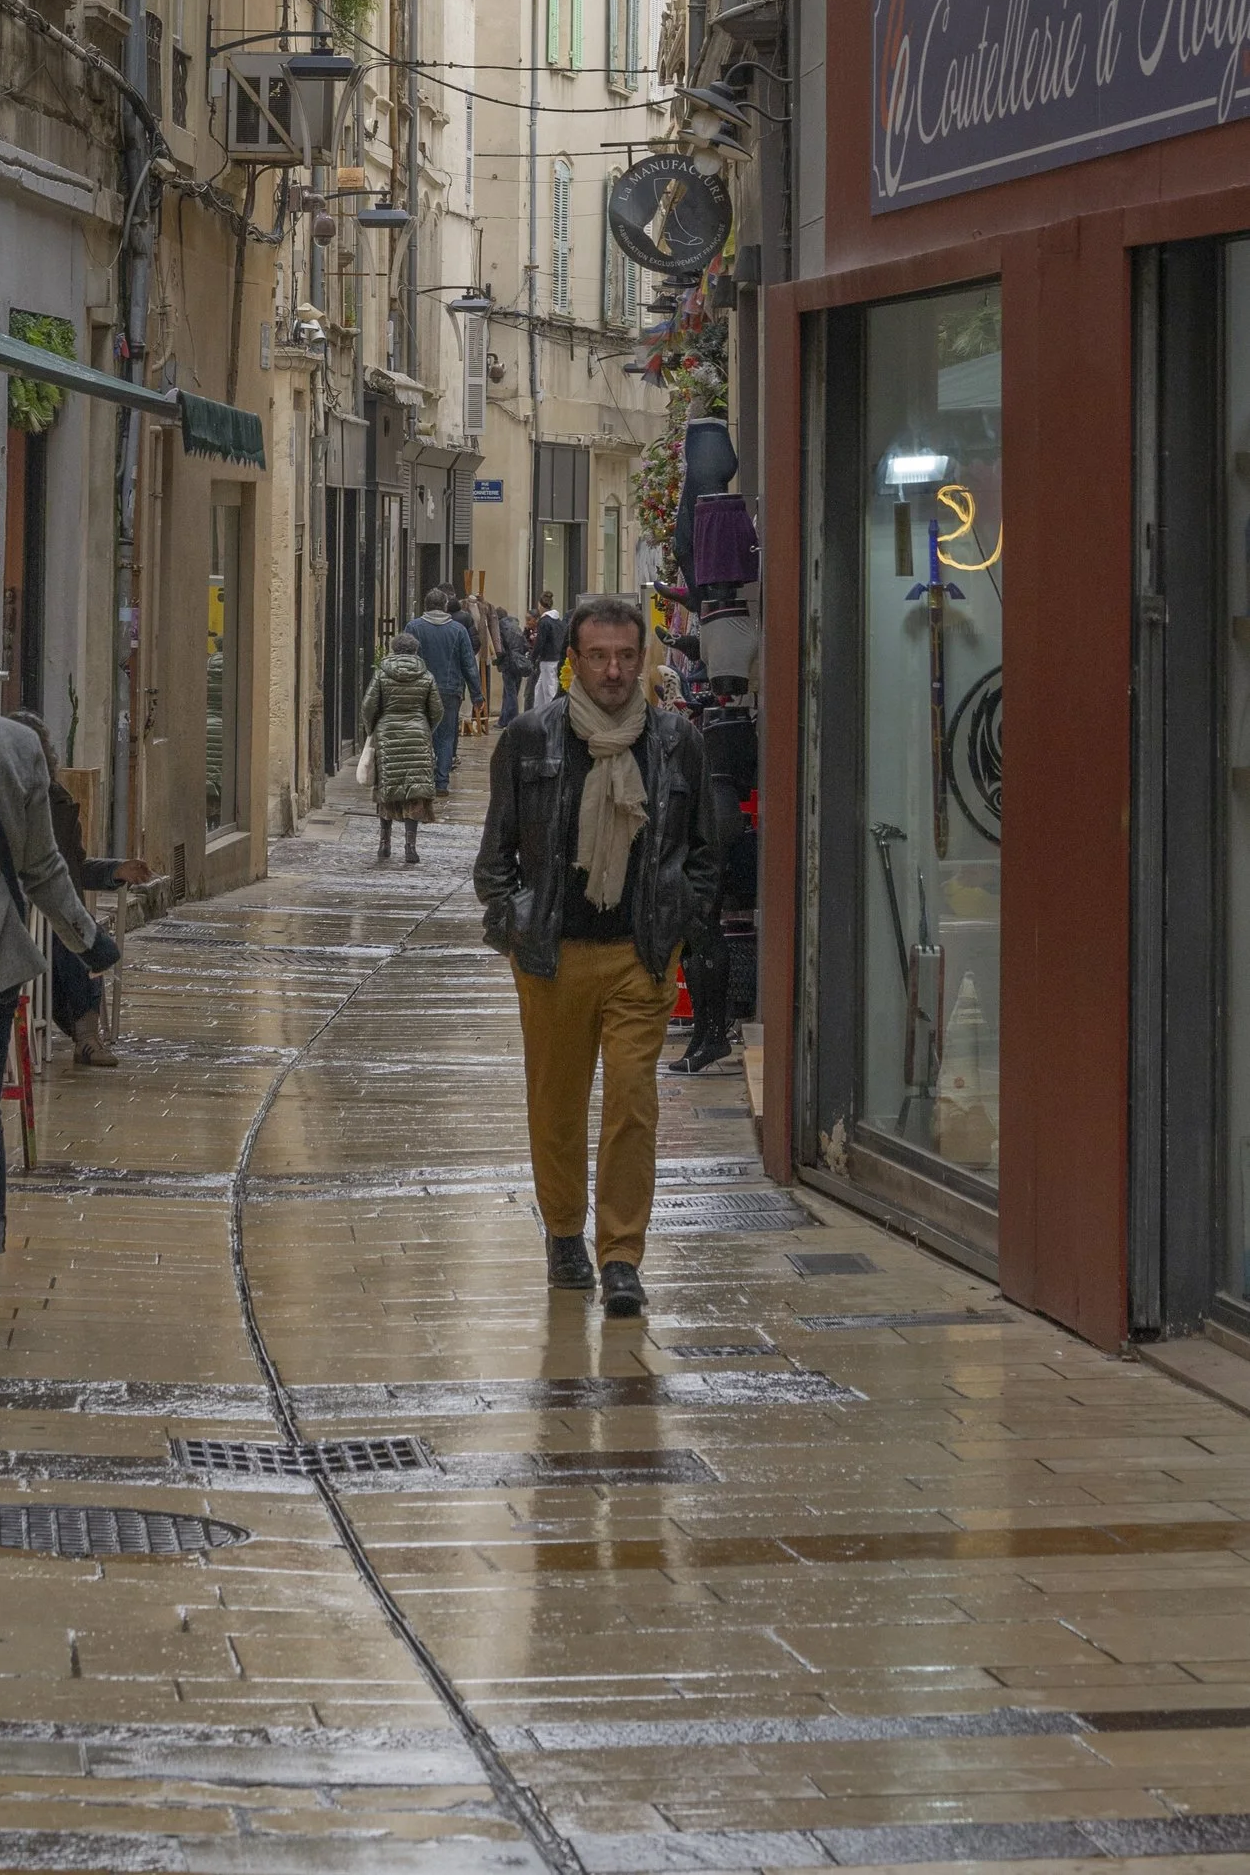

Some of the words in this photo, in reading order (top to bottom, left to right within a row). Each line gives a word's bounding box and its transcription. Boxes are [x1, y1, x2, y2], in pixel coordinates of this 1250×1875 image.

[618, 186, 632, 201] La
[630, 160, 725, 204] MANUFACURE
[617, 224, 648, 261] FABRICATION
[649, 253, 703, 267] EXCLUSIVEMENT
[703, 223, 726, 258] FRANÇAISE
